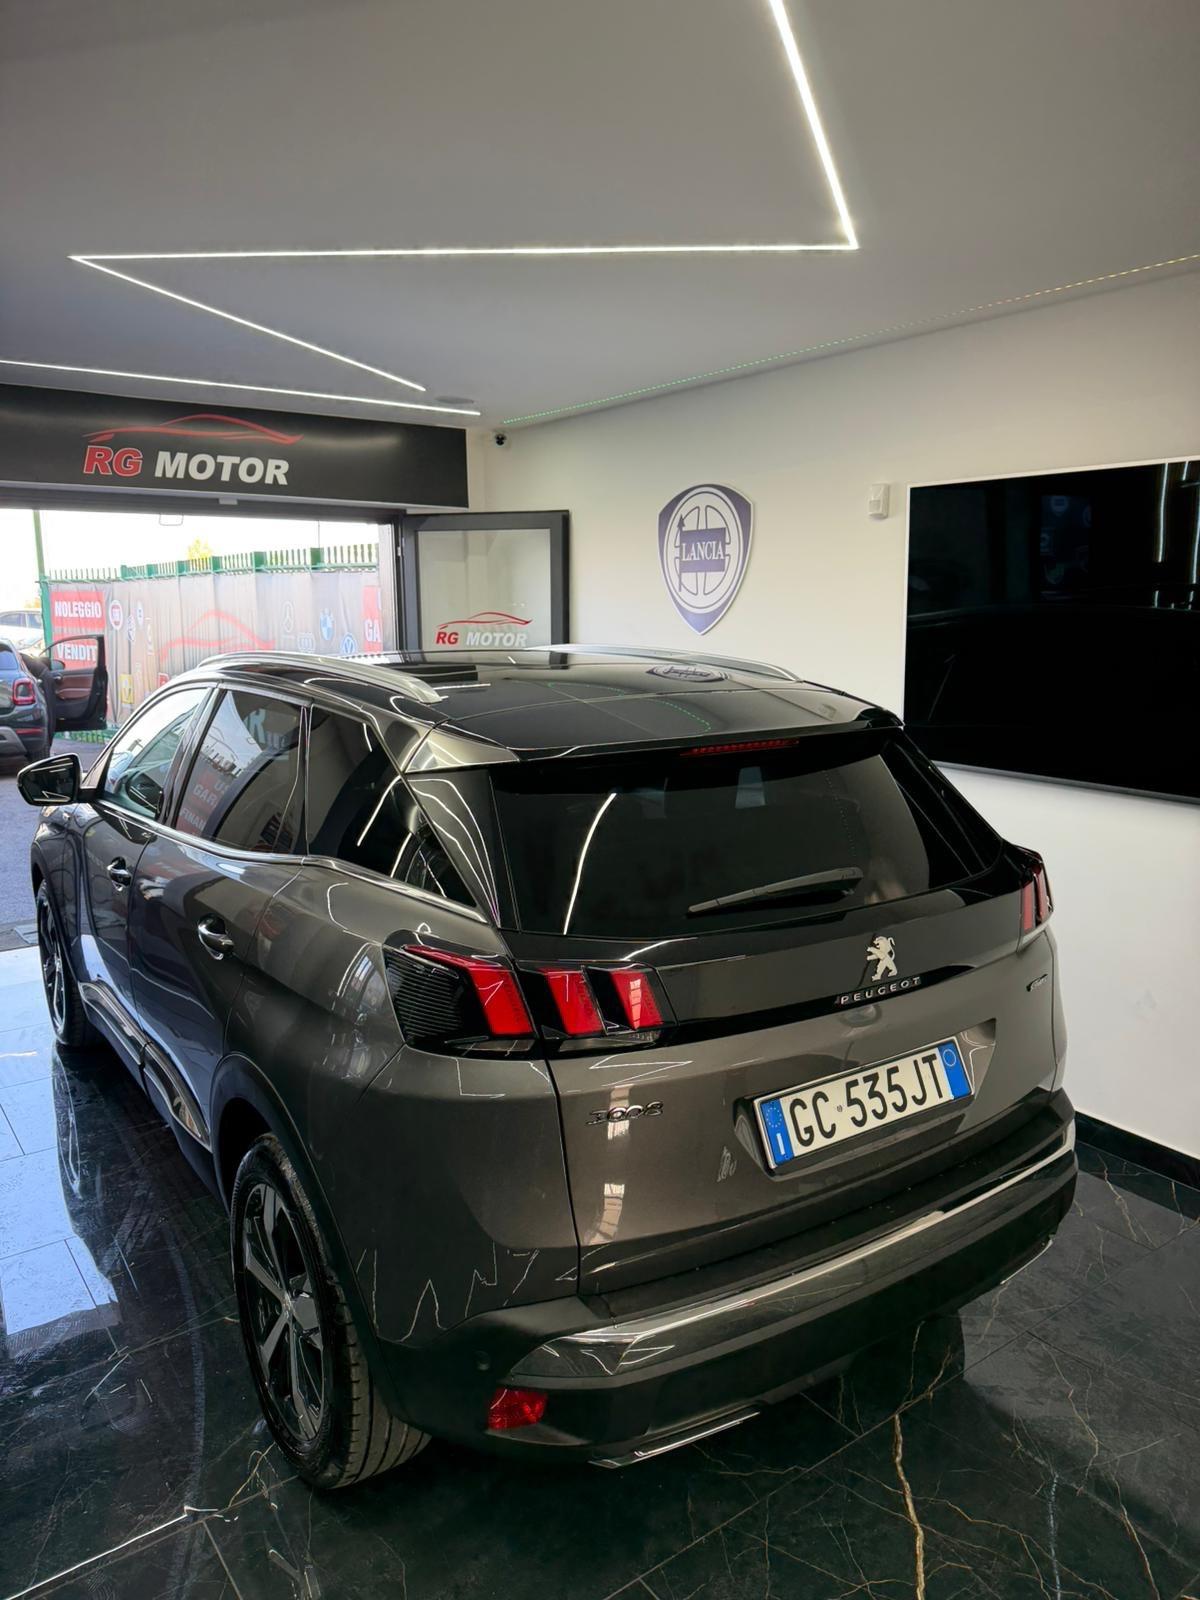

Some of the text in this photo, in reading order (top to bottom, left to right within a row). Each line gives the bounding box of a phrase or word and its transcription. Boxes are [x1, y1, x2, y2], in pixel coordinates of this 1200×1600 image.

[83, 446, 290, 486] RG MOTOR
[682, 541, 724, 561] LANCIA
[55, 601, 102, 618] NOLEGGIO
[436, 632, 527, 647] RG MOTOR
[840, 976, 922, 1005] PEUGEOT
[789, 1090, 836, 1147] GC
